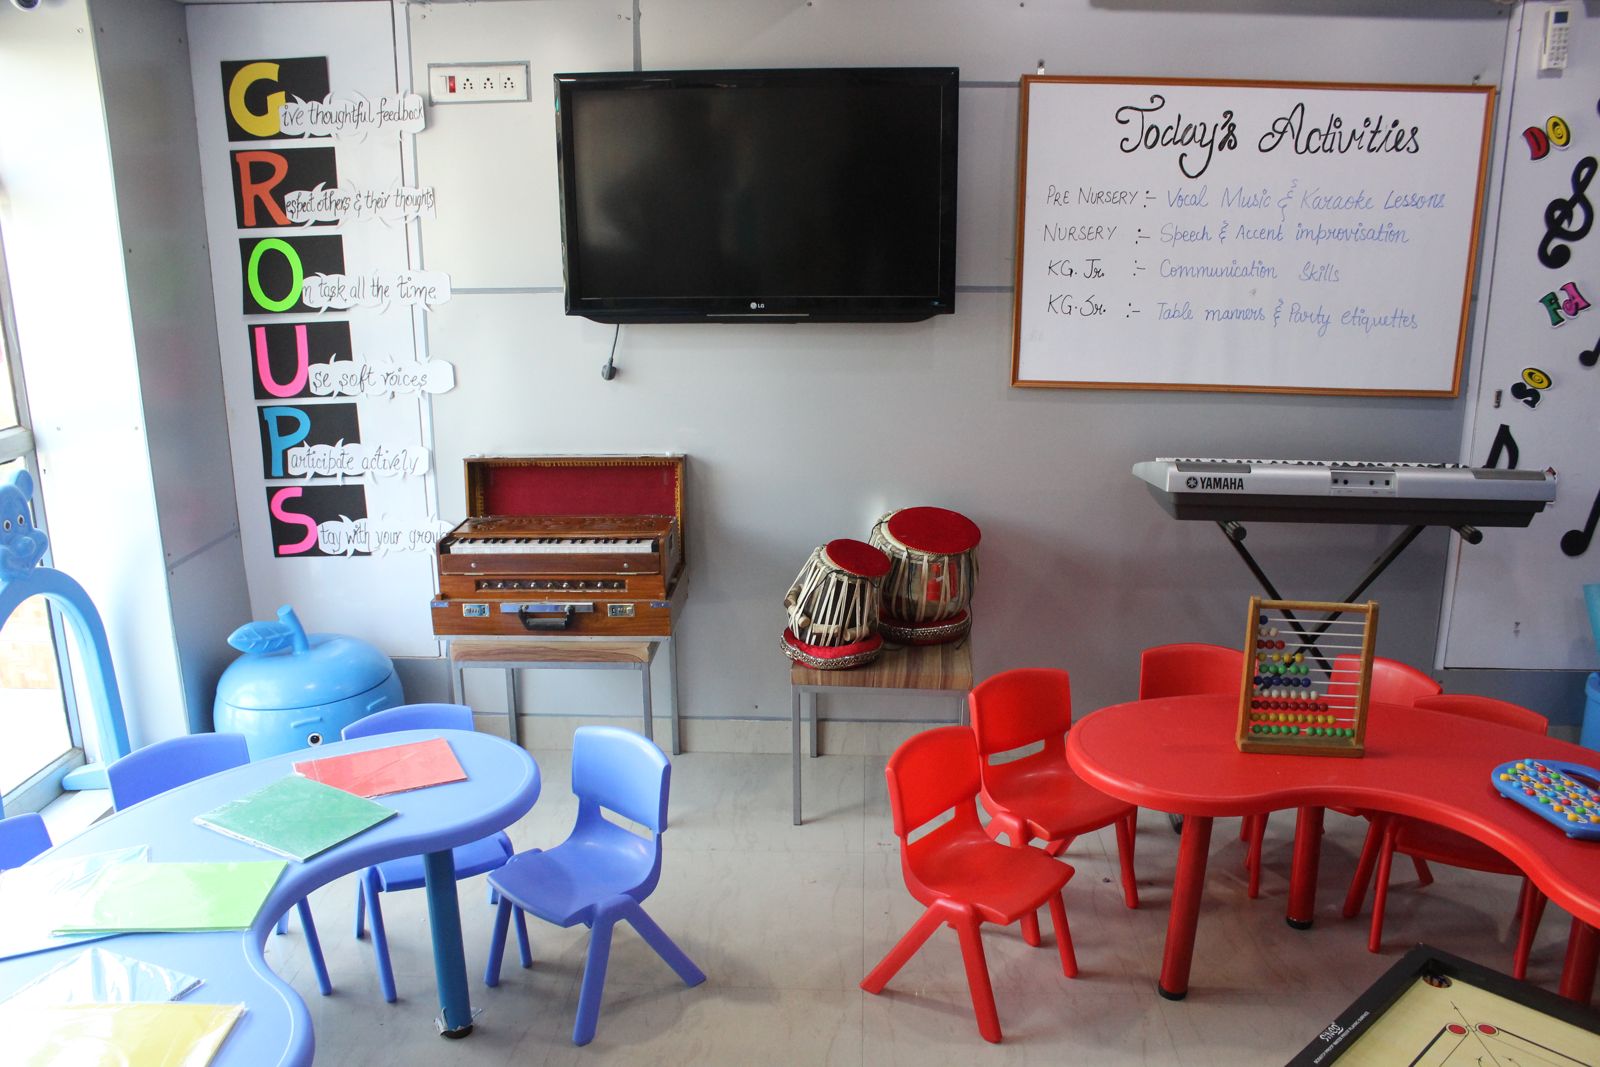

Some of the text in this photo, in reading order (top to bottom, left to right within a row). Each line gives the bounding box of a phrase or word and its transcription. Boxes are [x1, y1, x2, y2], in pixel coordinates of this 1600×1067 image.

[308, 101, 375, 130] thoughtful
[376, 97, 424, 128] feedback
[1115, 94, 1420, 179] Today's Activities
[317, 189, 351, 216] others
[365, 190, 391, 214] their
[393, 187, 434, 214] thoughts
[1078, 186, 1138, 206] NURSERY
[1167, 185, 1208, 208] Vocal
[1221, 186, 1272, 209] Music
[1300, 187, 1375, 210] Karaoke
[1384, 190, 1446, 210] Lessons
[1043, 223, 1118, 243] NURSERY
[1160, 222, 1212, 247] Speech
[1236, 223, 1284, 241] Accent
[1295, 222, 1409, 246] improvisation
[1160, 258, 1278, 280] Communication
[1299, 260, 1340, 283] Skills
[318, 276, 347, 302] task
[350, 276, 365, 299] all
[370, 275, 390, 304] the
[1158, 301, 1193, 321] Table
[1205, 306, 1266, 322] manners
[1289, 302, 1332, 337] Party
[1341, 306, 1419, 334] etiquettes
[338, 364, 377, 392] soft
[380, 367, 428, 389] voices
[361, 444, 420, 472] actively
[1200, 477, 1245, 490] YAMAHA
[345, 523, 371, 552] with
[375, 530, 402, 550] your
